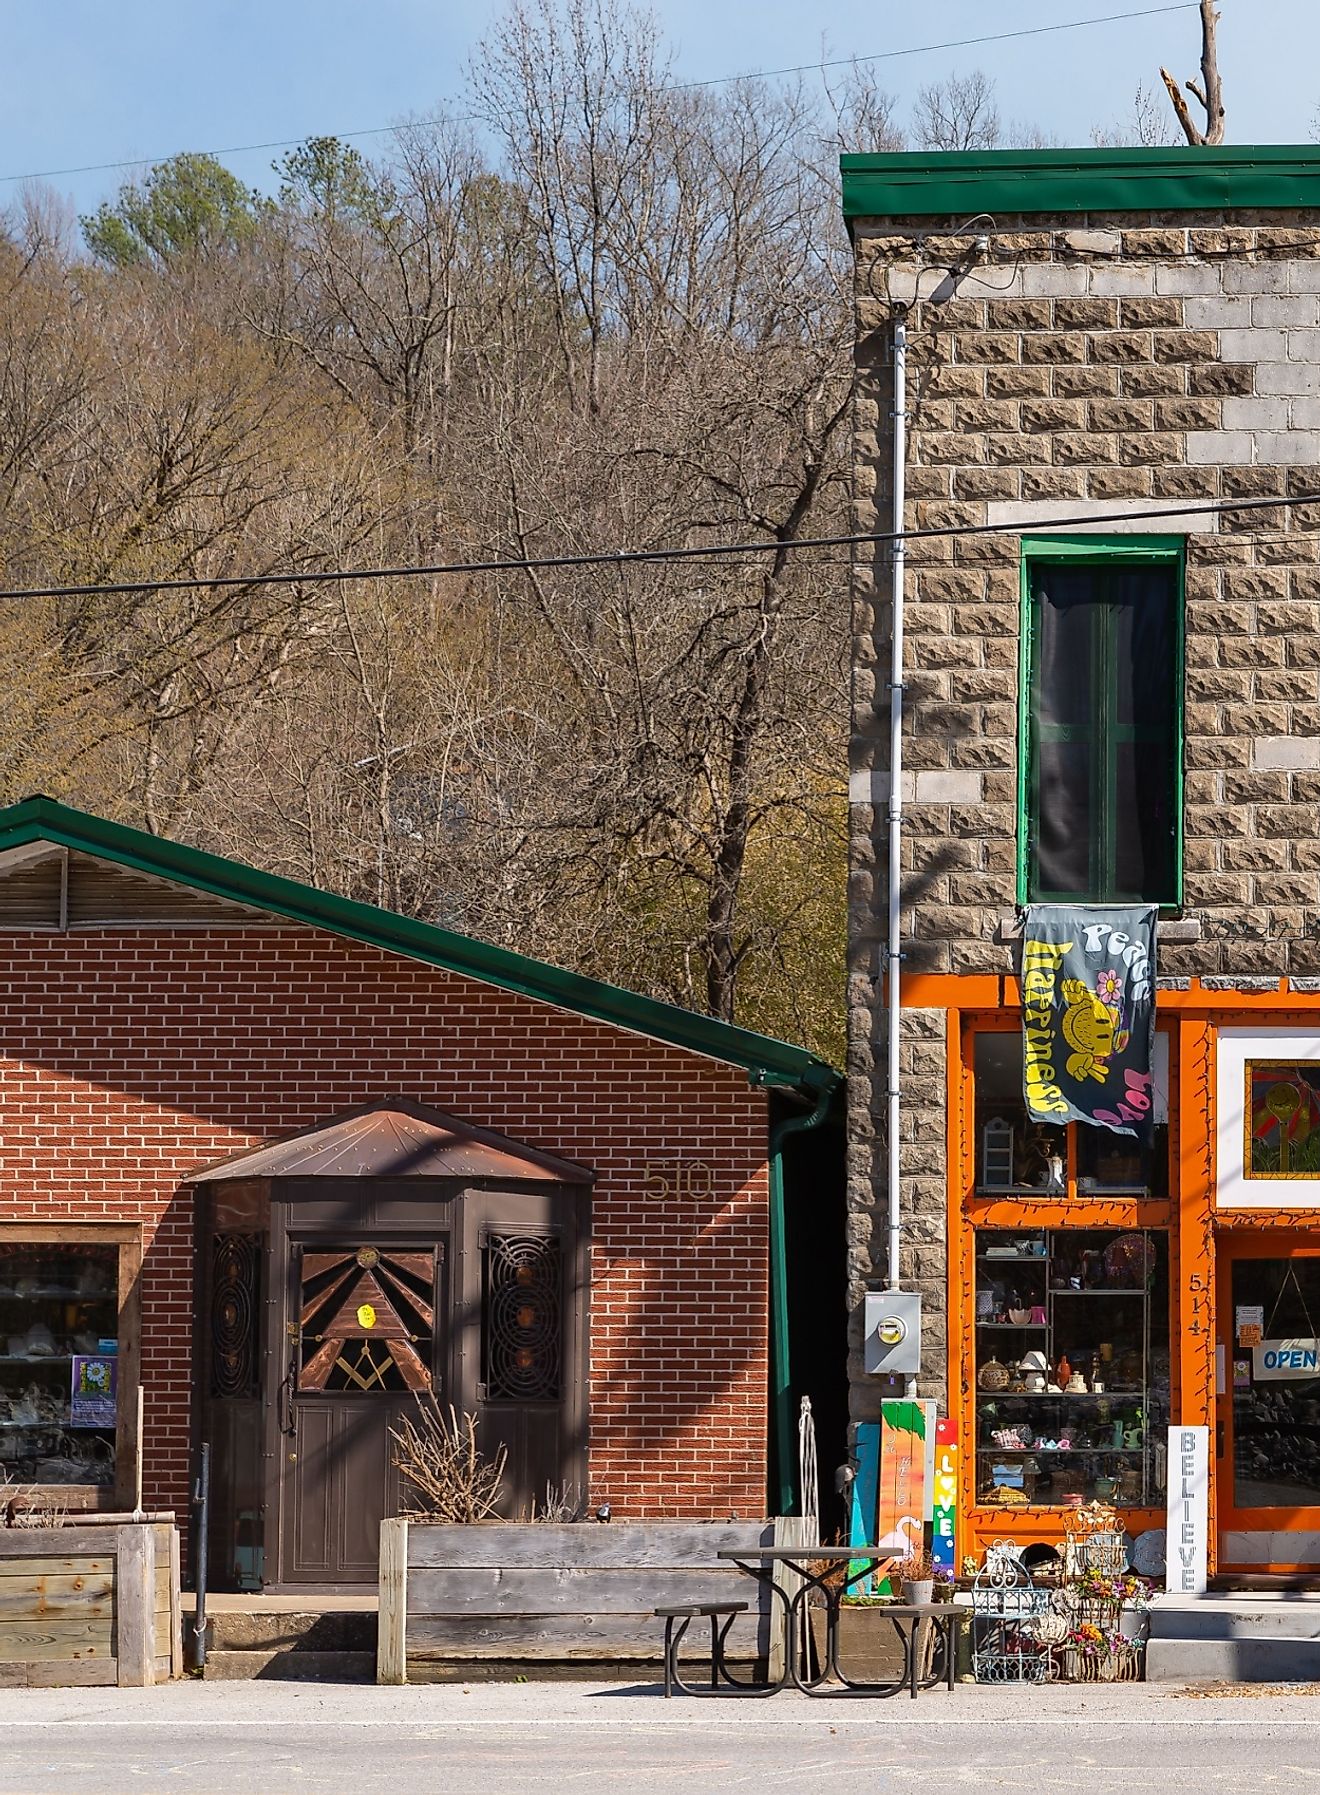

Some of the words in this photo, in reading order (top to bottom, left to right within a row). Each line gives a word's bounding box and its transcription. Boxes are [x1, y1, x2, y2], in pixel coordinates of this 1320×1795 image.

[645, 1161, 711, 1201] 510
[1187, 1273, 1202, 1336] 514
[1263, 1350, 1318, 1370] OPEN
[1178, 1431, 1197, 1591] BELIEVE
